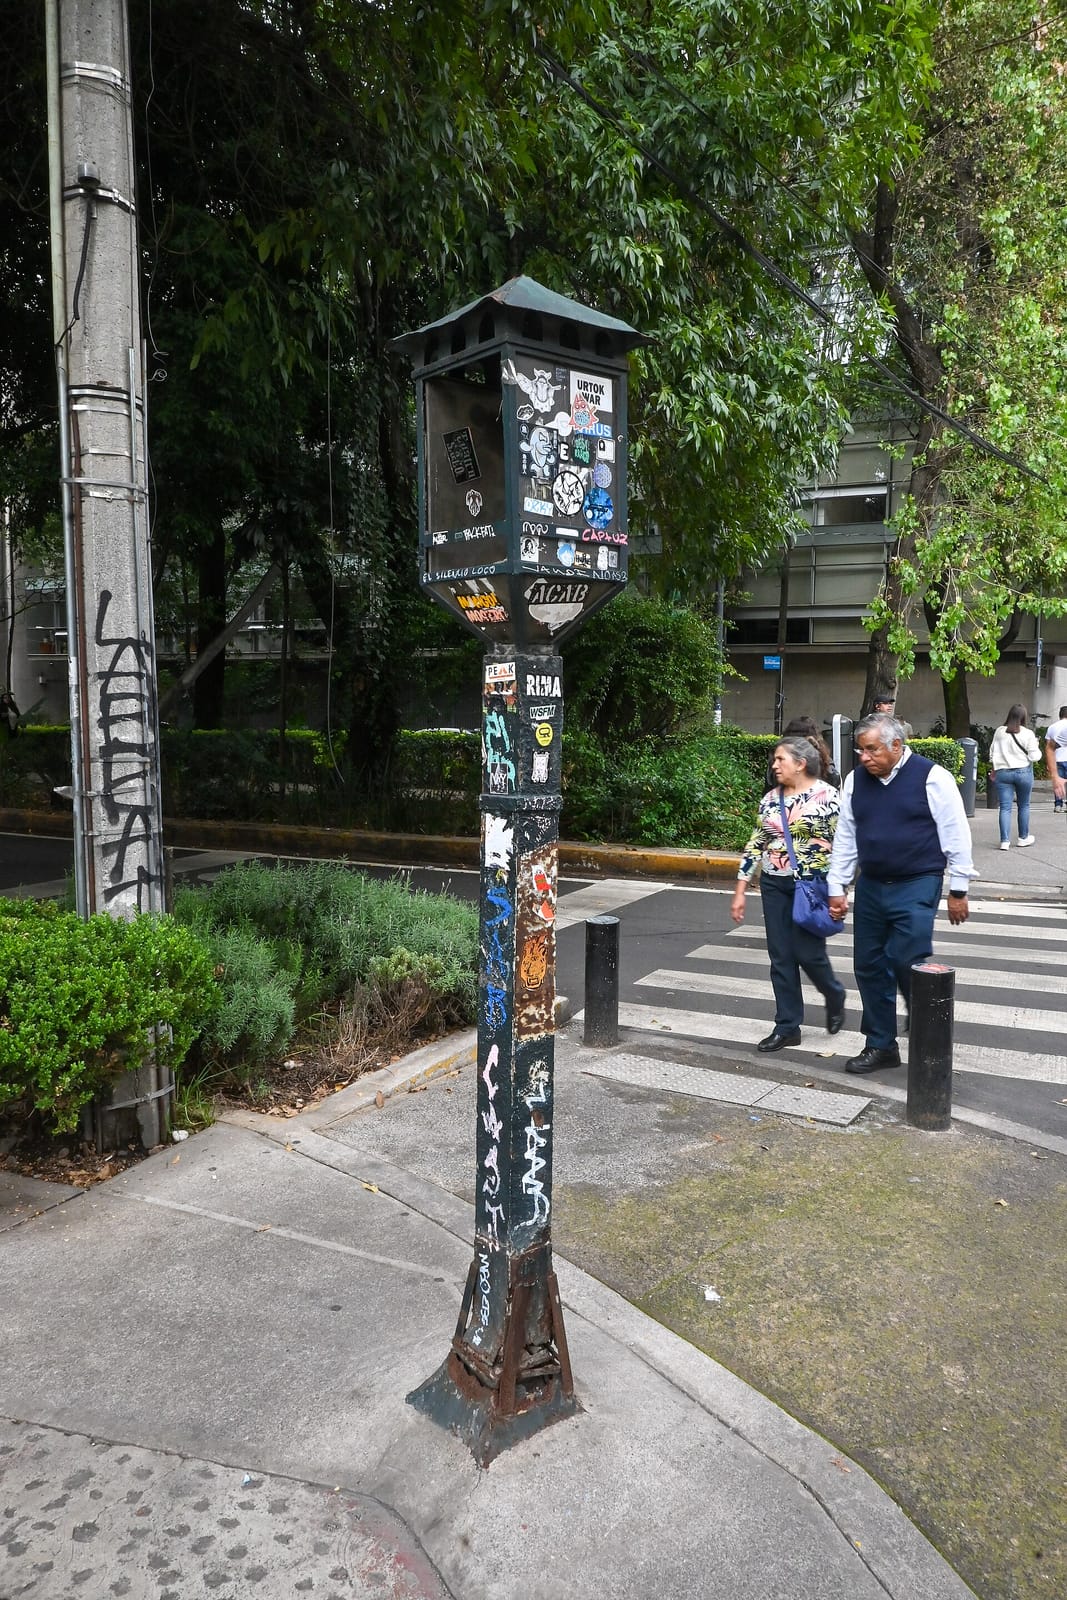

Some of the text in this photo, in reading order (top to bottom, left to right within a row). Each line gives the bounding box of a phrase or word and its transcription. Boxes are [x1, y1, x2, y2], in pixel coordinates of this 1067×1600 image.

[577, 379, 605, 396] URTOK
[582, 391, 601, 406] WAR
[471, 565, 496, 575] LOCO
[532, 583, 589, 604] ACAB
[530, 705, 555, 718] WSFM
